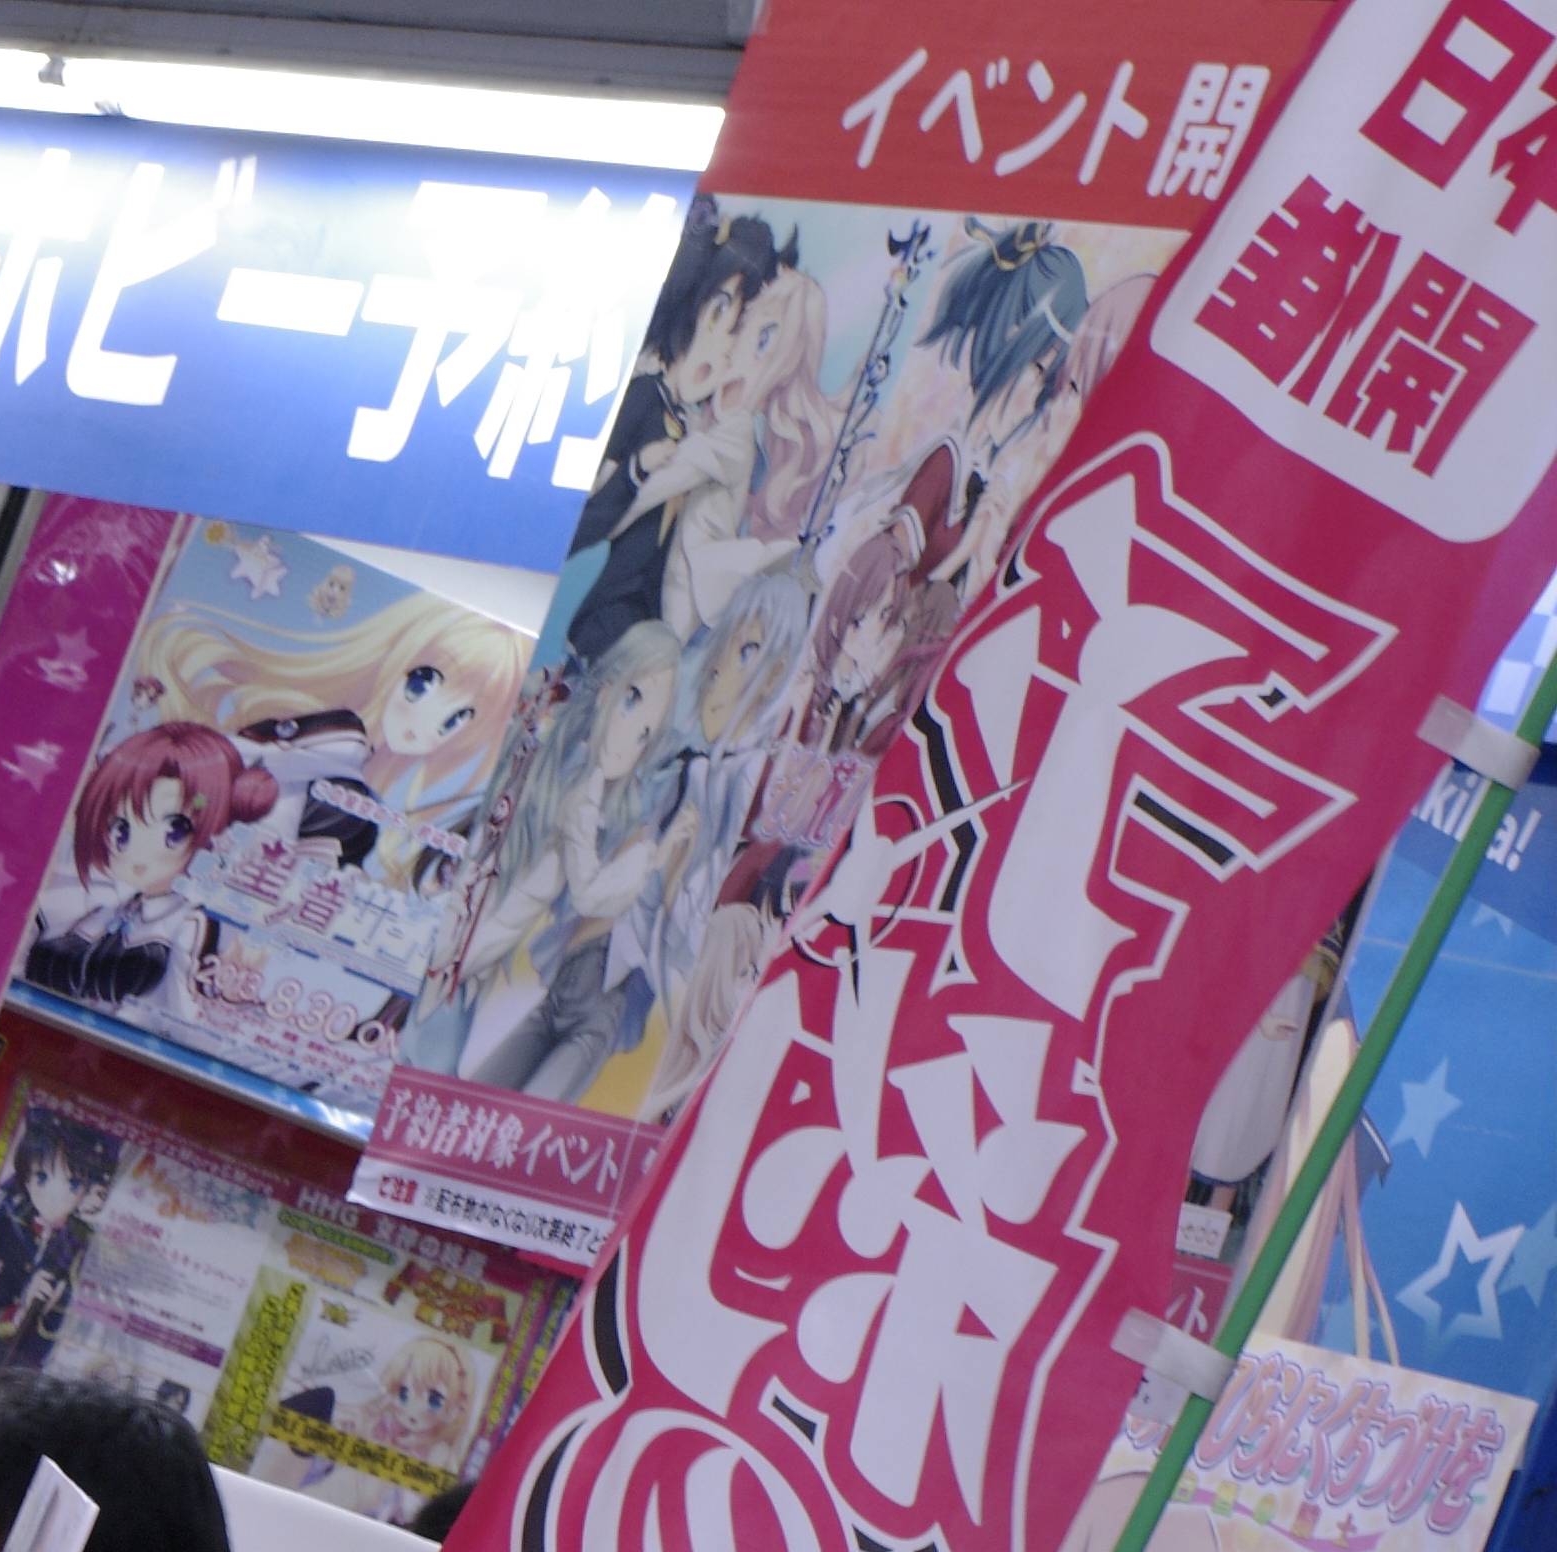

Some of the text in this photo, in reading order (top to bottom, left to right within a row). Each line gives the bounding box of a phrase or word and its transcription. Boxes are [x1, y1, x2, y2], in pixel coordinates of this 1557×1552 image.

[842, 47, 1271, 201] イベント開
[381, 1085, 621, 1196] 予約者対象イベント
[424, 1180, 616, 1258] ※配布物がなくなり次第終了と
[1125, 1352, 1506, 1536] びらにくちづけを
